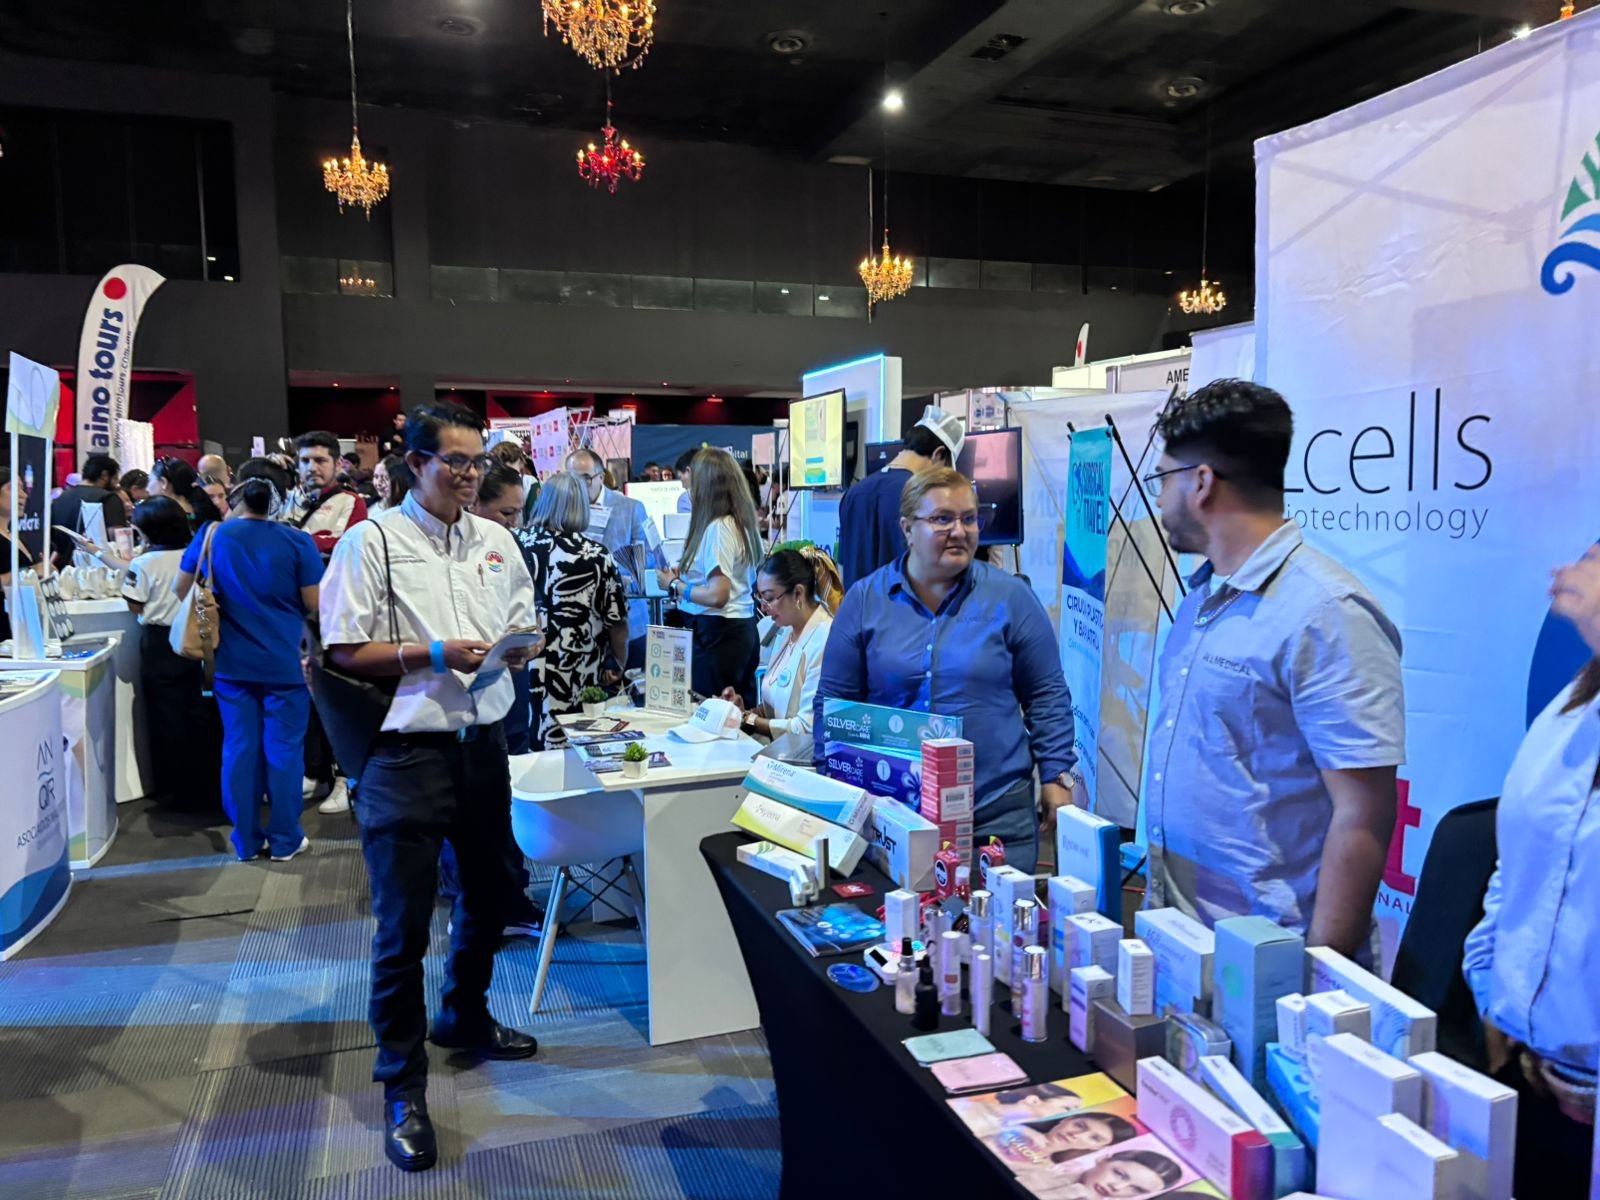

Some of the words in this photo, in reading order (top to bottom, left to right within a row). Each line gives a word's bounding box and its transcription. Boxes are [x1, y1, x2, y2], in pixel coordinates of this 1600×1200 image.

[89, 307, 124, 380] tours
[1166, 368, 1190, 384] AME
[84, 386, 111, 450] aino
[1284, 387, 1492, 494] cells
[827, 716, 871, 734] SILVERCARE
[773, 763, 796, 778] Mirena
[871, 825, 897, 855] TRUST
